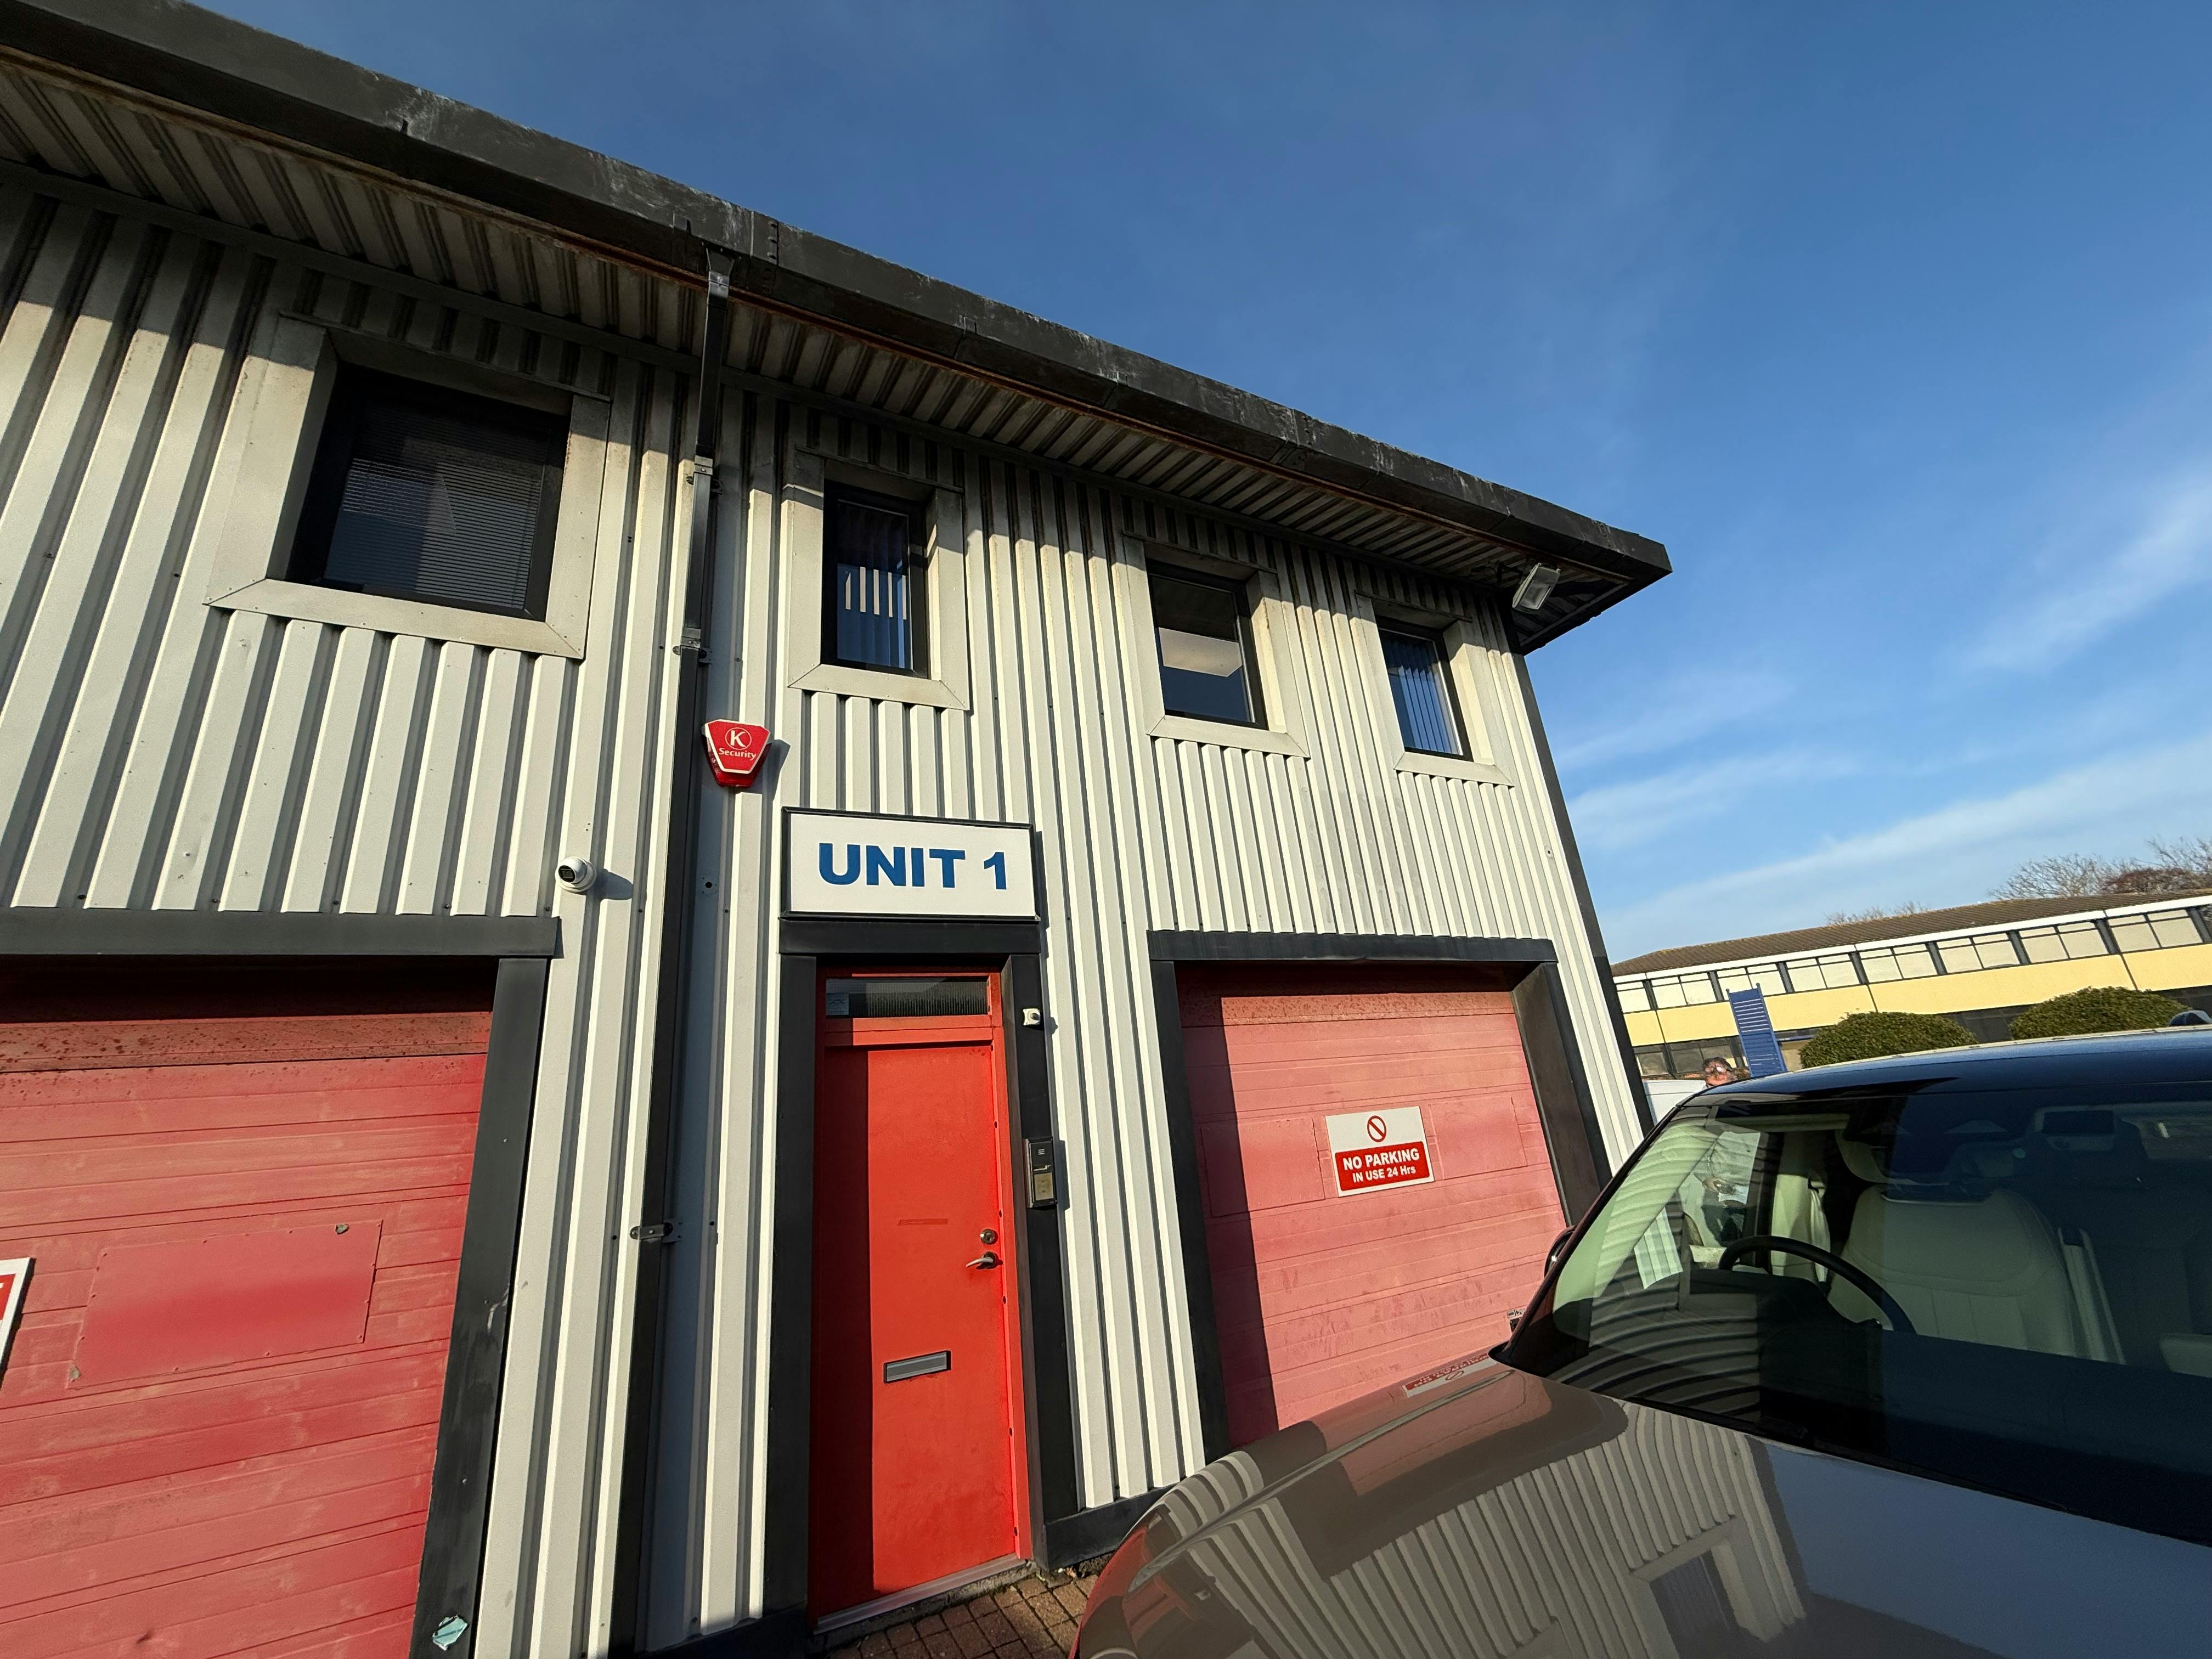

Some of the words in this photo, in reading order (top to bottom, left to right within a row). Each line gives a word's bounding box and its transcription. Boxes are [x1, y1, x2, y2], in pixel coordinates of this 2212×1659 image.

[730, 730, 747, 747] K
[719, 747, 757, 761] Security
[819, 843, 966, 888] UNIT
[984, 851, 1007, 890] 1
[1342, 1156, 1362, 1171] NO
[1364, 1148, 1420, 1167] PARKING
[1352, 1171, 1364, 1183] IN
[1365, 1169, 1385, 1181] USE
[1386, 1166, 1398, 1178] 24
[1400, 1165, 1417, 1176] Hrs
